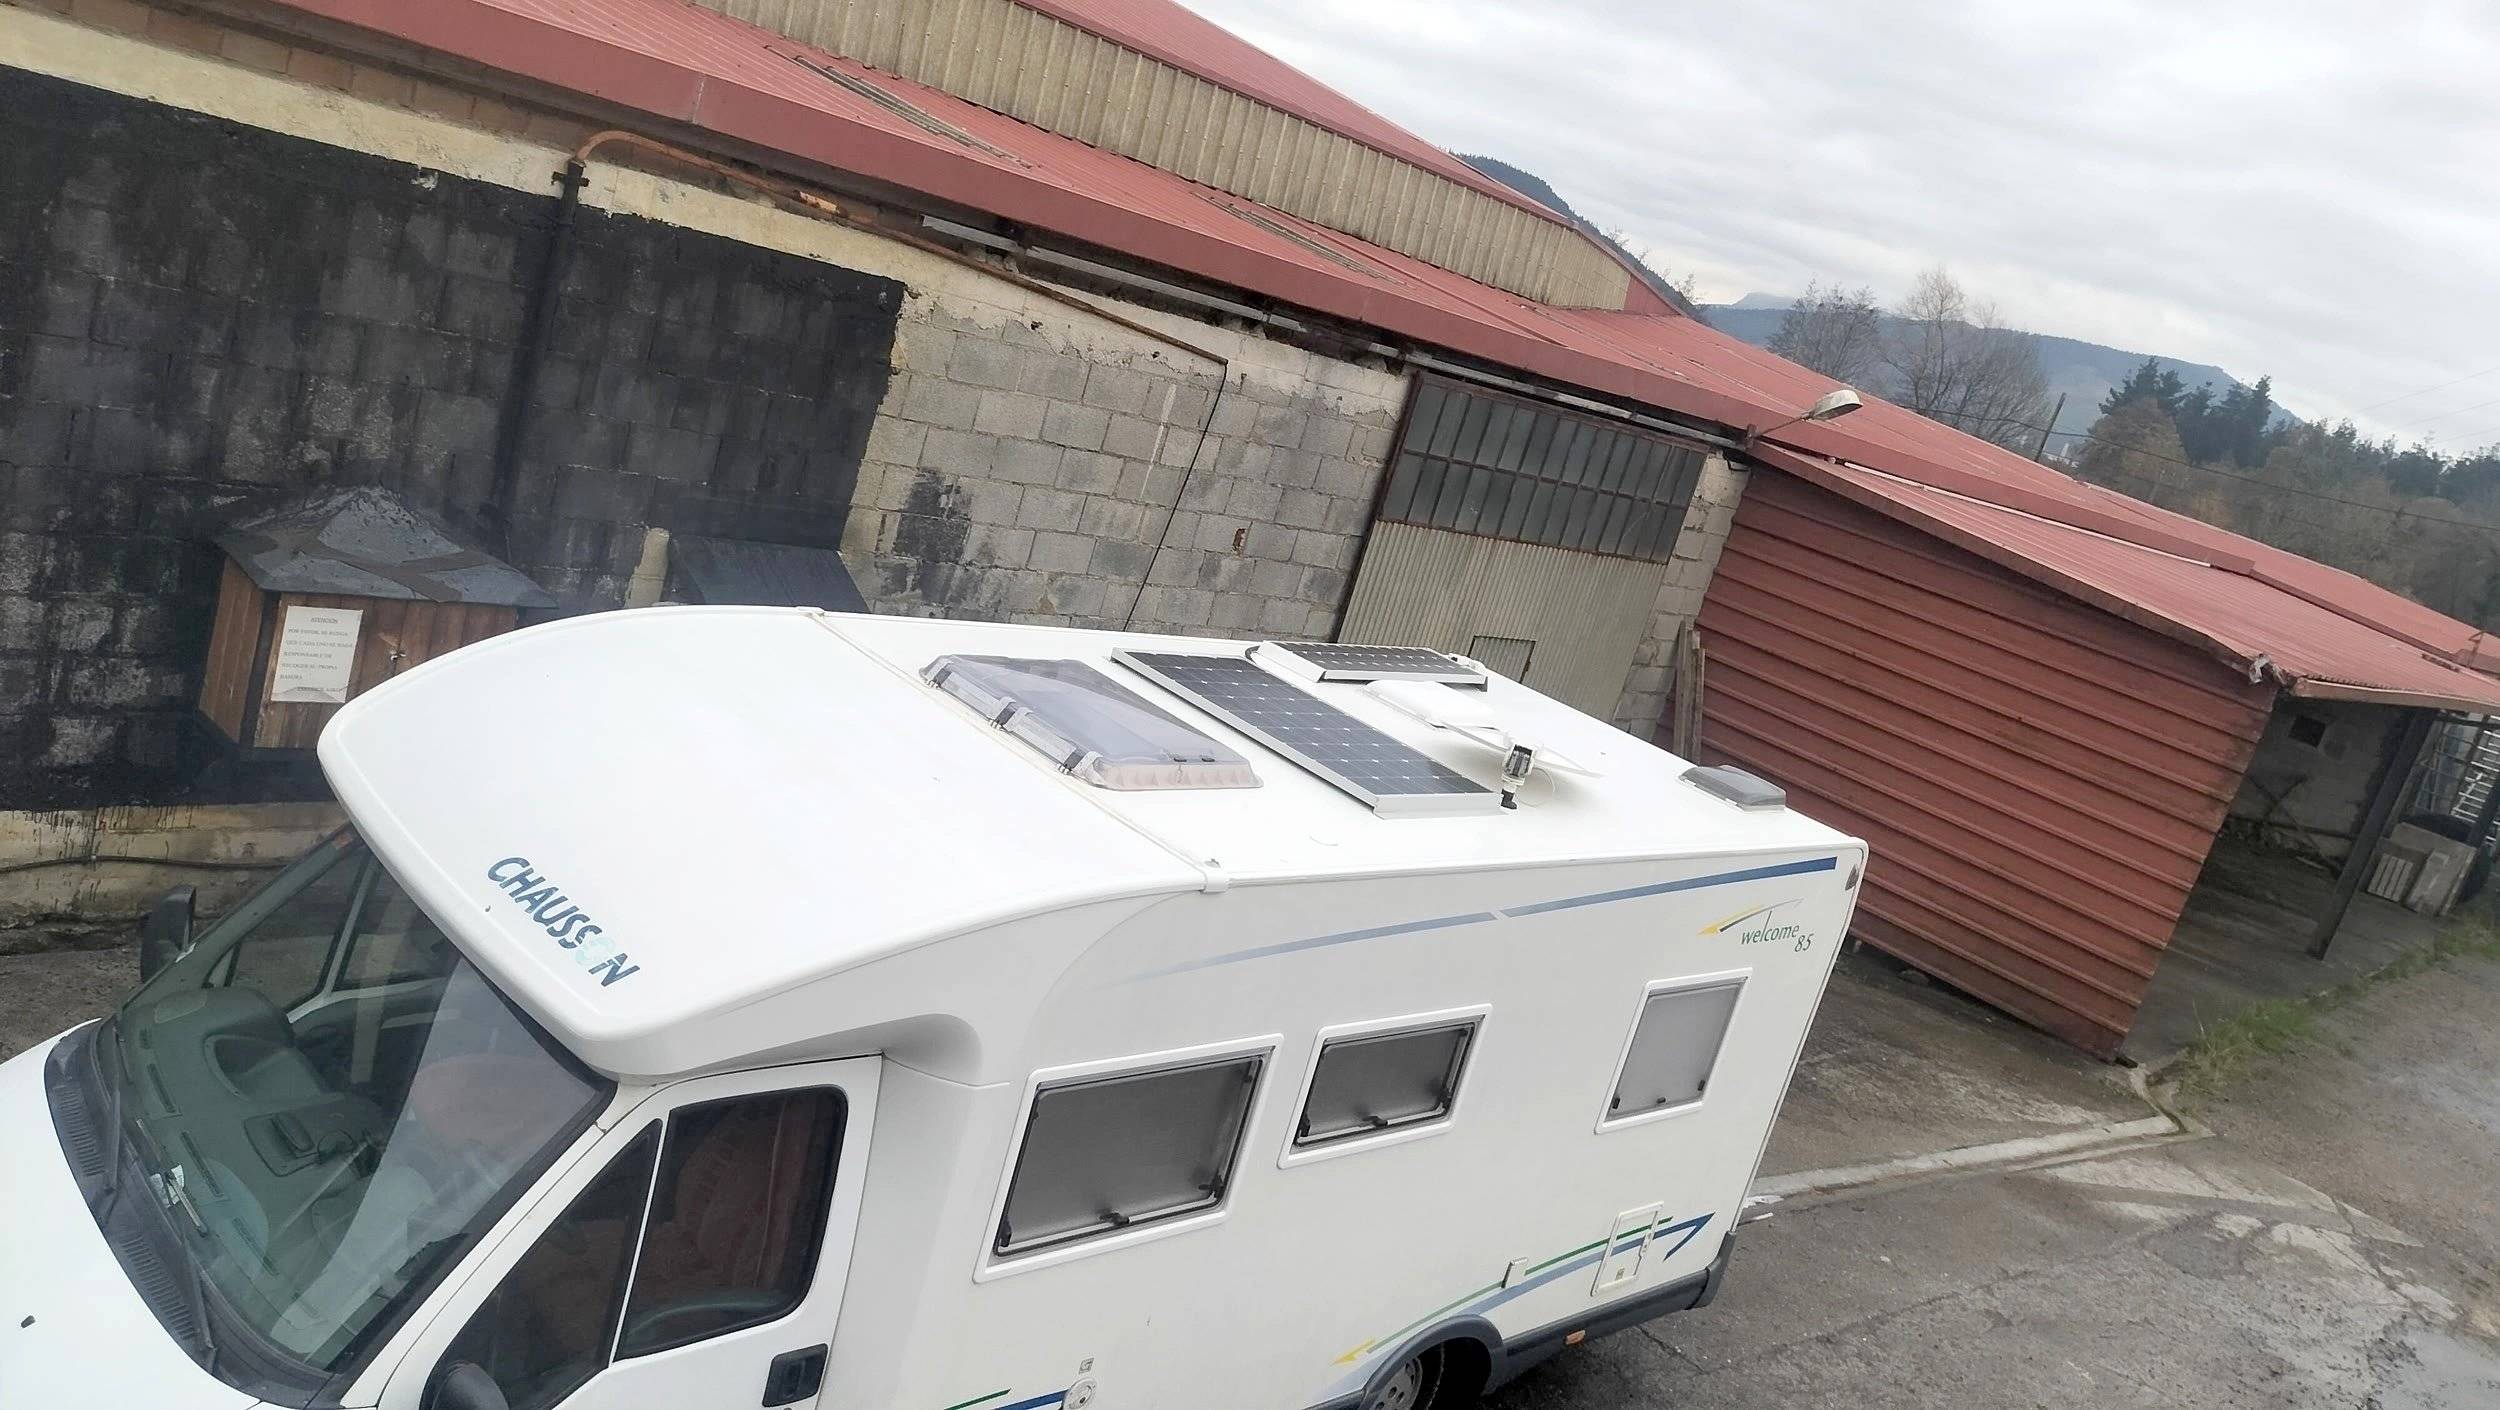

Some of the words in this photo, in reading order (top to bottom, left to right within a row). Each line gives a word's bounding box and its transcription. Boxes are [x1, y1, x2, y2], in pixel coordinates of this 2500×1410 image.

[487, 857, 641, 987] CHAUSSON
[1741, 910, 1800, 945] welcome
[1794, 933, 1814, 953] 85
